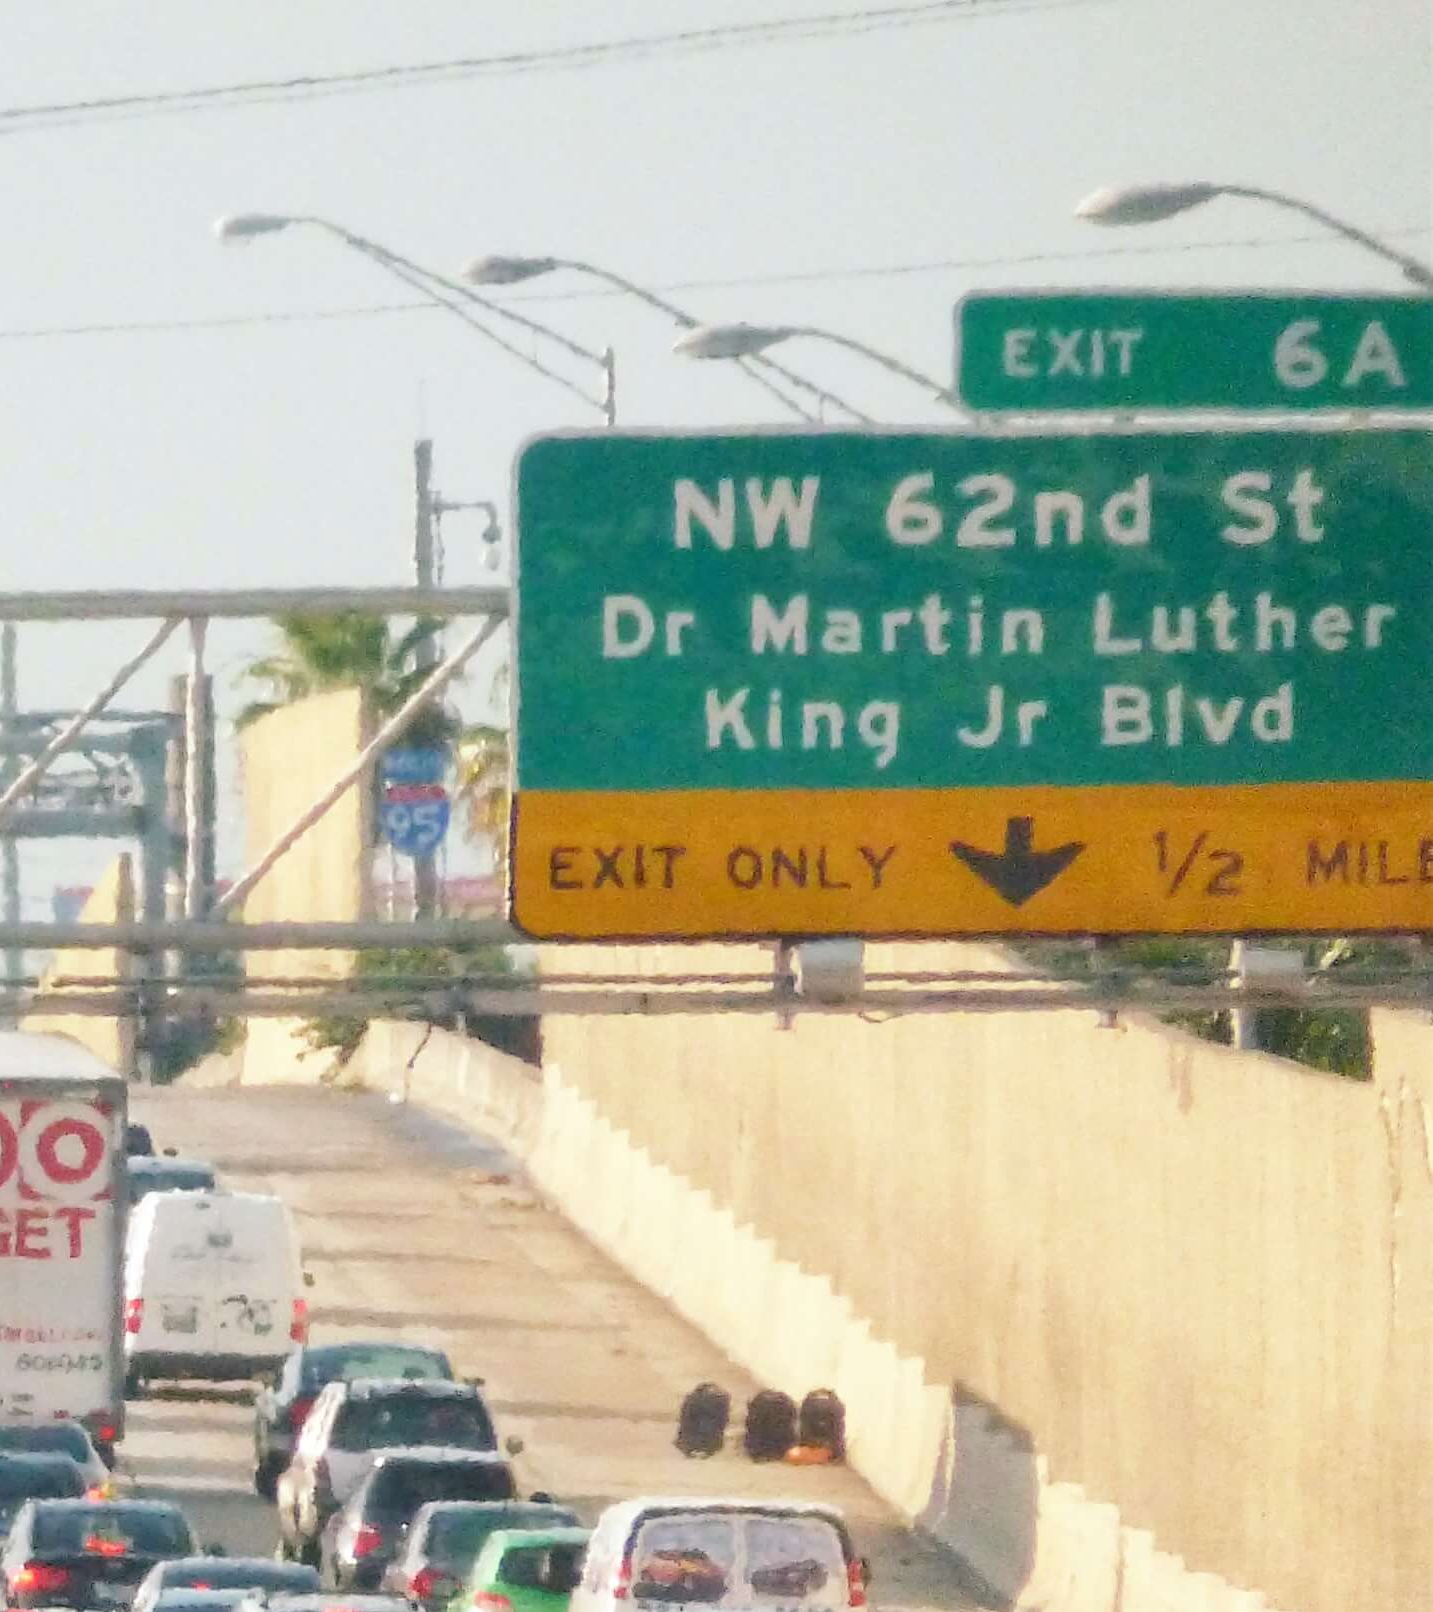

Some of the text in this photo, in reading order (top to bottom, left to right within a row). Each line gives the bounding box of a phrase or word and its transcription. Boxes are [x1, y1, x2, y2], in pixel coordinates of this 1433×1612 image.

[1002, 318, 1406, 390] EXIT 6A
[674, 469, 1326, 550] NW 62nd St
[601, 590, 1397, 659] Dr Martin Luther
[704, 682, 1295, 769] King Jr Blvd
[386, 805, 442, 846] 95
[550, 845, 686, 890] EXIT
[727, 844, 900, 890] ONLY
[1154, 830, 1246, 899] 1/2
